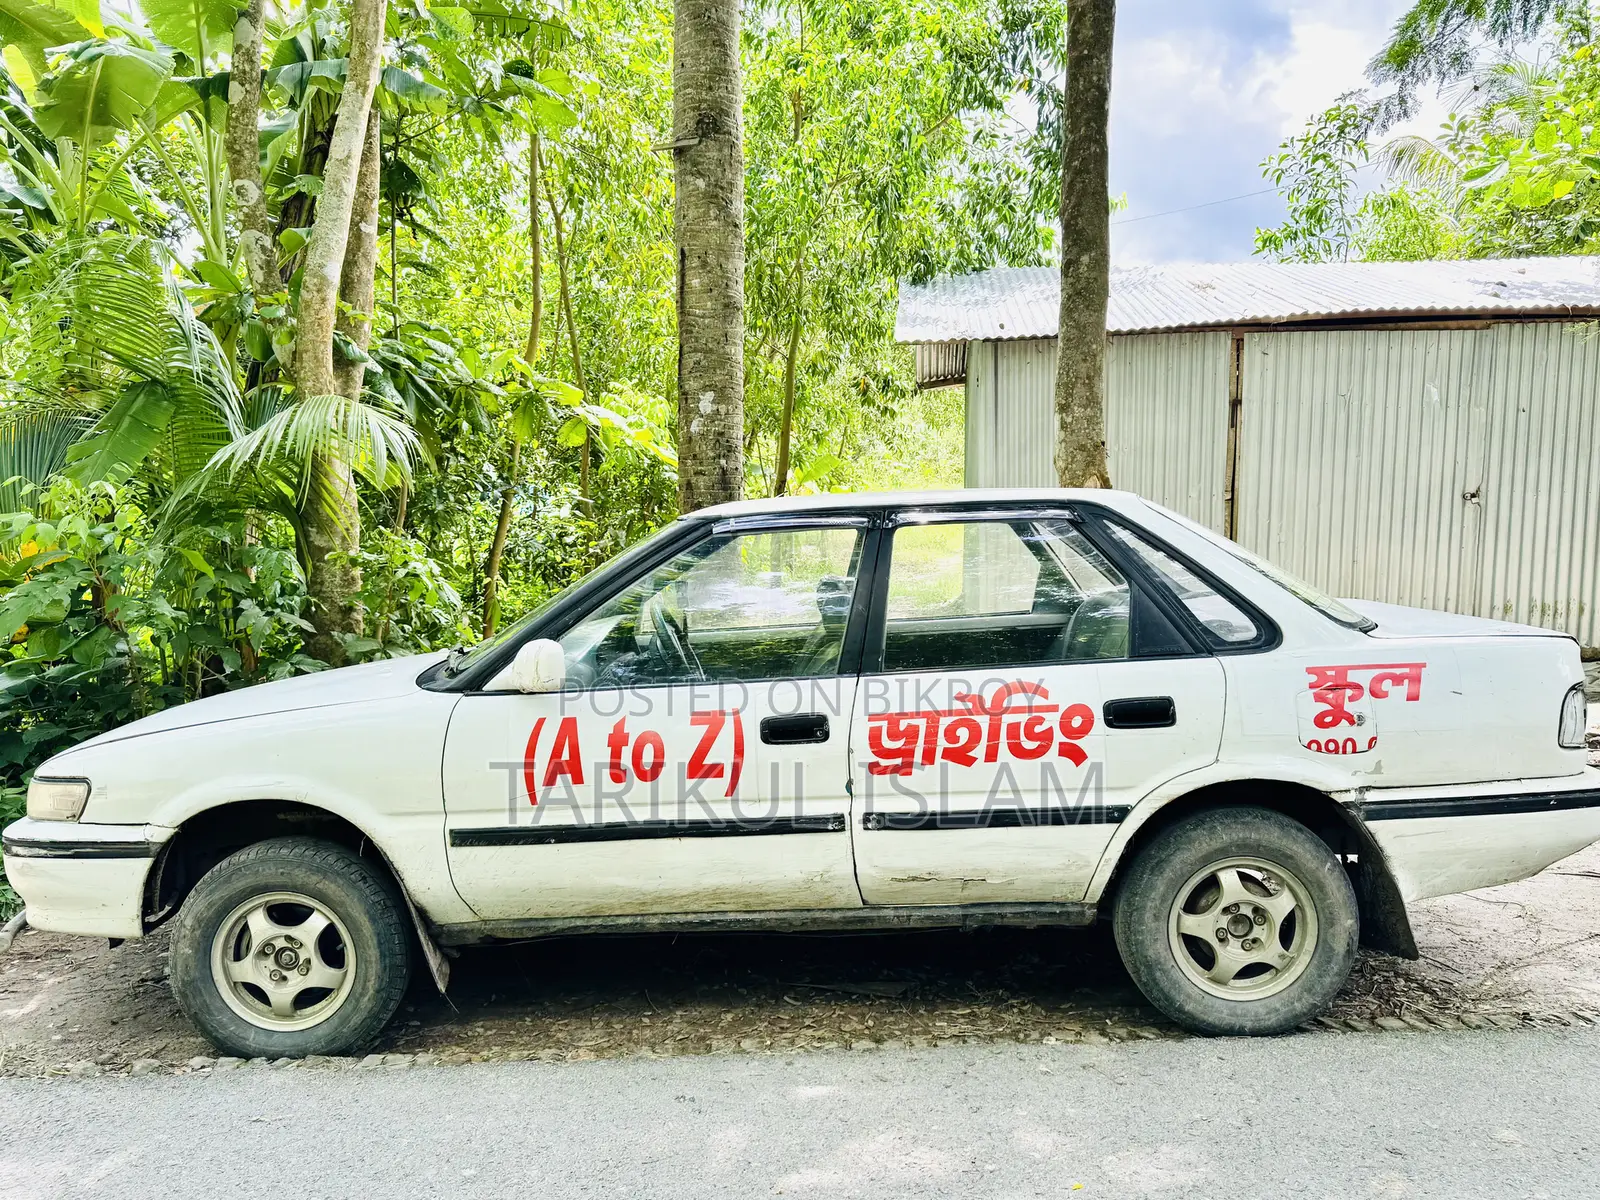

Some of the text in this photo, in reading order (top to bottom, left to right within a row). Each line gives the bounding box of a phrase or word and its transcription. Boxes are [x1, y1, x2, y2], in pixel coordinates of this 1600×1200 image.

[1305, 663, 1426, 729] স্কুল
[524, 708, 744, 805] (A to Z)
